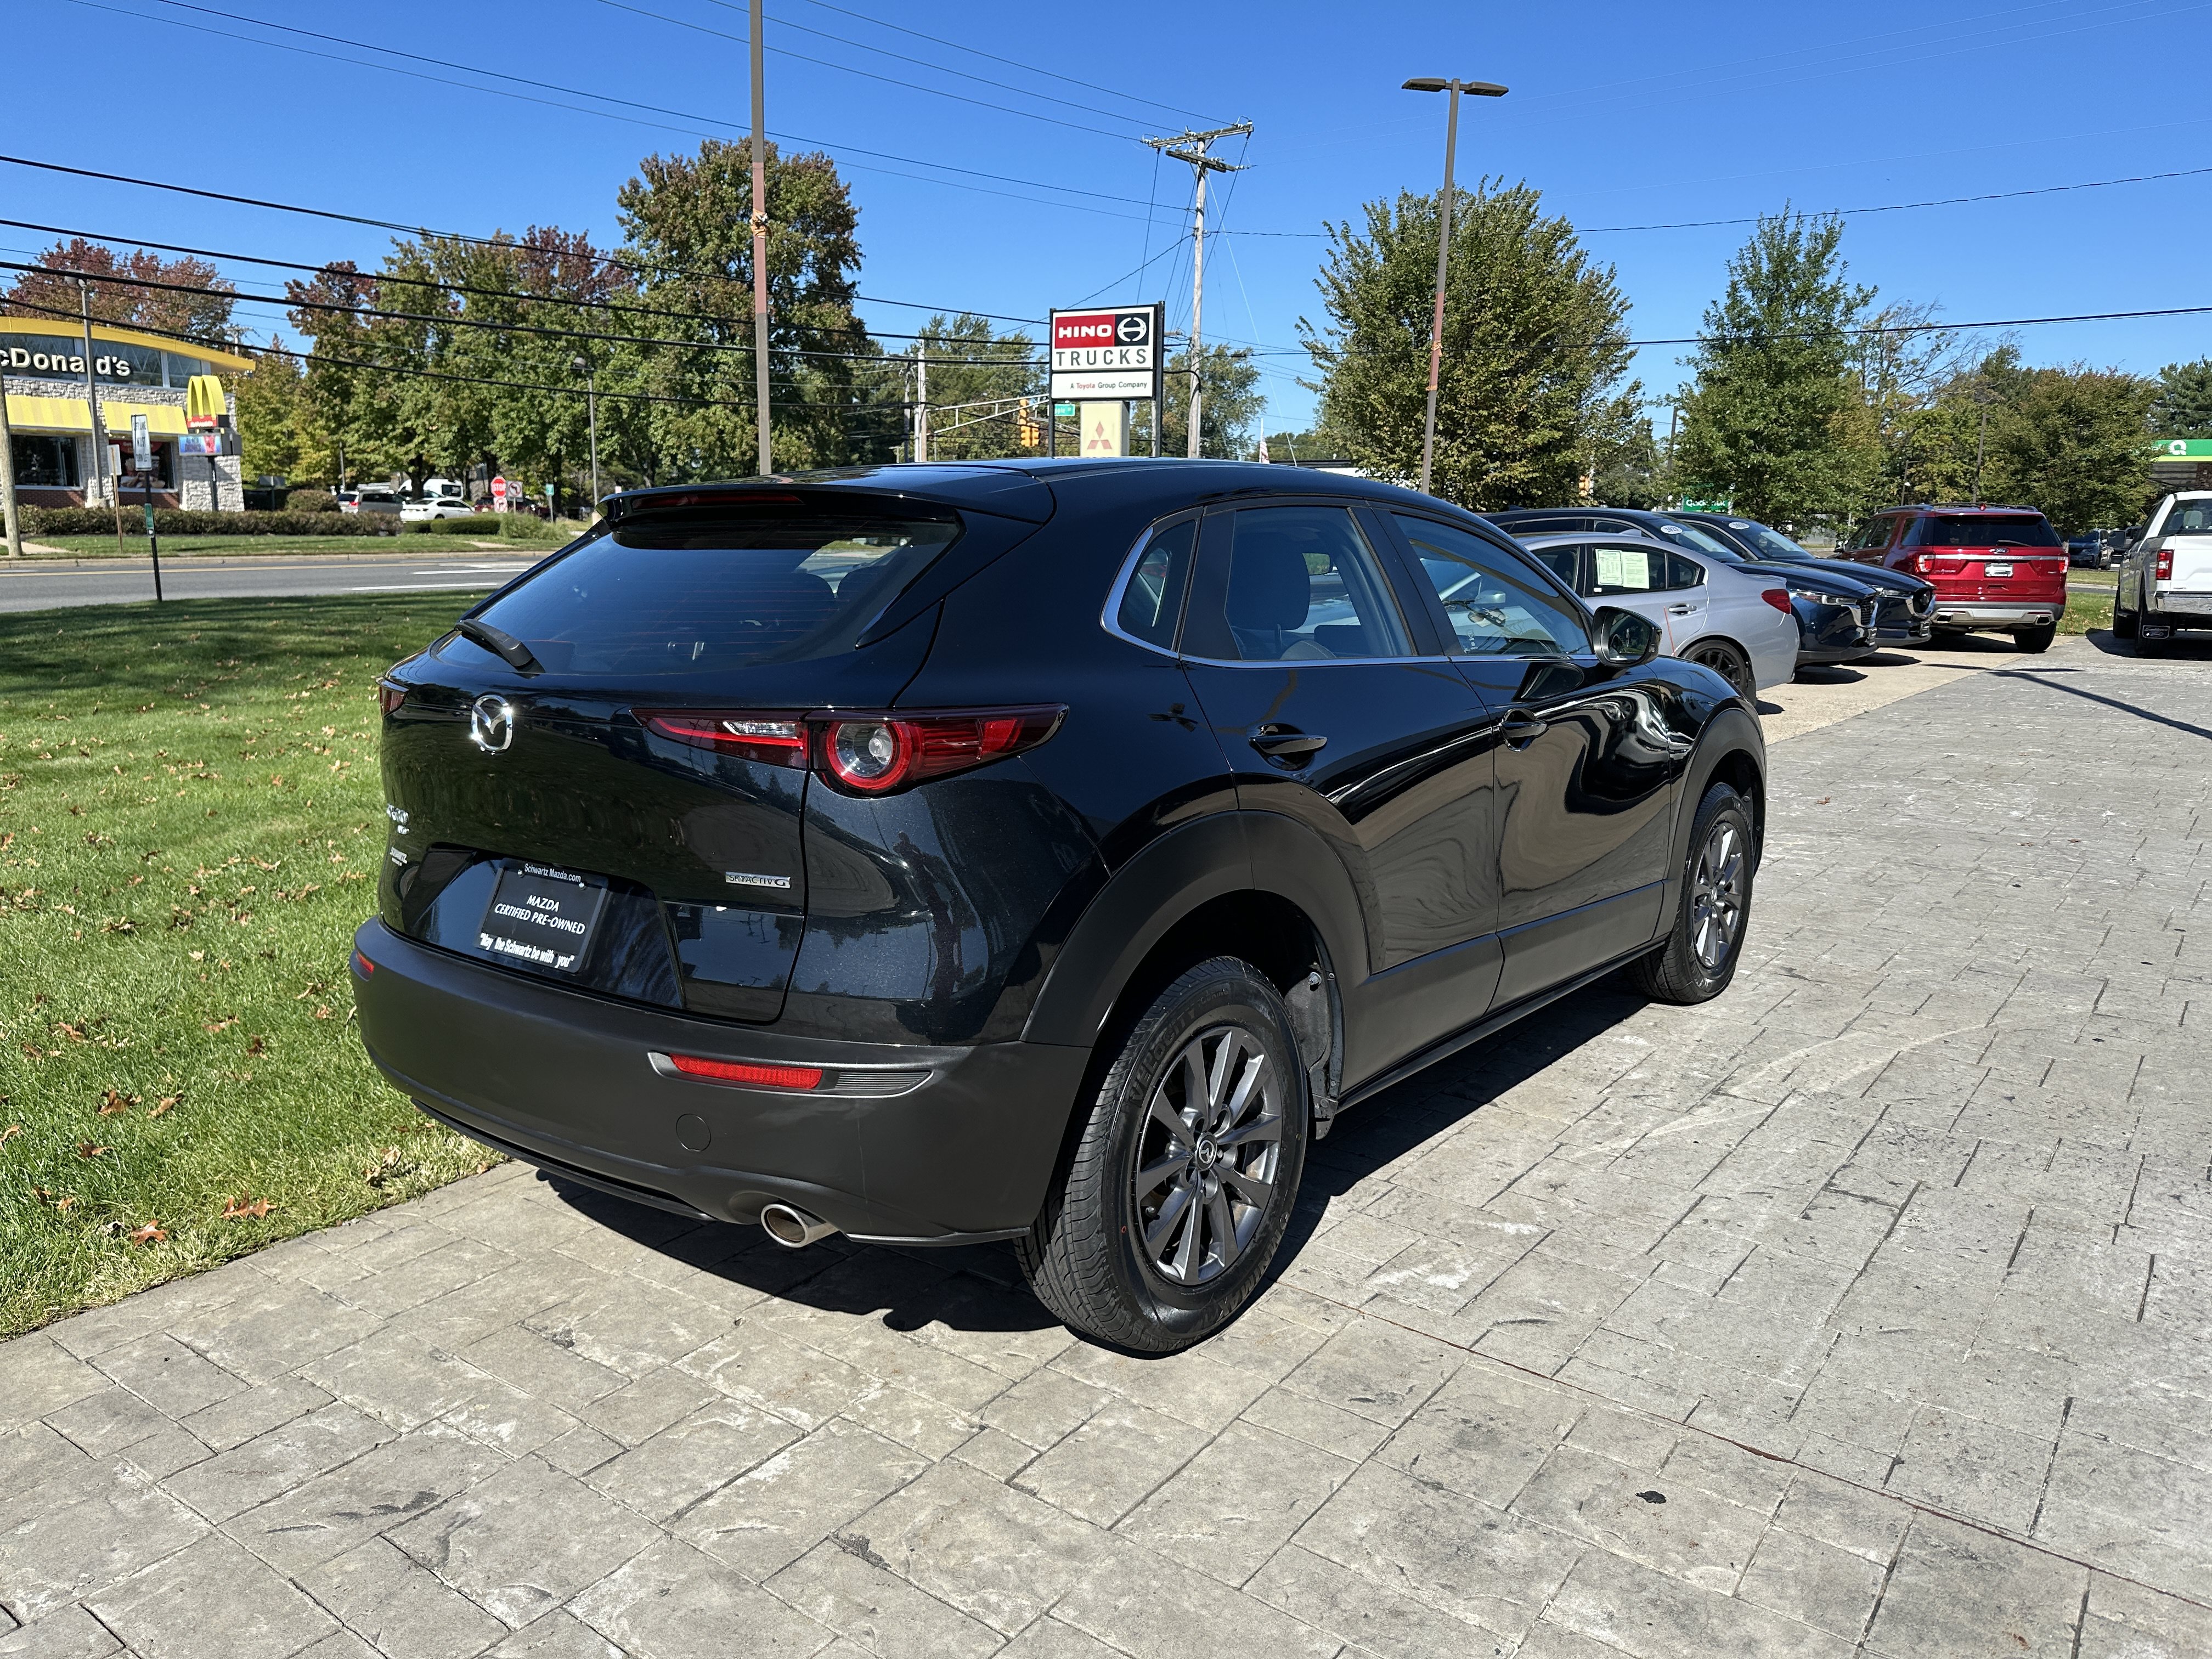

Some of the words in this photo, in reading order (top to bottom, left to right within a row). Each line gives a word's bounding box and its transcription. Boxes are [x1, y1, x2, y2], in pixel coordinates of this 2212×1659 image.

[1058, 324, 1112, 338] HINO
[0, 347, 131, 377] cDonad's
[1056, 348, 1146, 366] TRUCKS
[493, 483, 506, 492] STOP
[524, 863, 548, 877] Schwartz
[549, 868, 582, 883] Mazda.com
[526, 895, 560, 912] MAZDA
[494, 903, 531, 921] CERTIFIED
[531, 912, 586, 934] PRE-OWNED
[480, 932, 494, 951] "May
[495, 936, 506, 951] the
[504, 939, 532, 957] Schwartz
[531, 945, 540, 960] be
[539, 949, 555, 964] with
[555, 954, 575, 969] you"
[1130, 1005, 1196, 1104] VELOCITY
